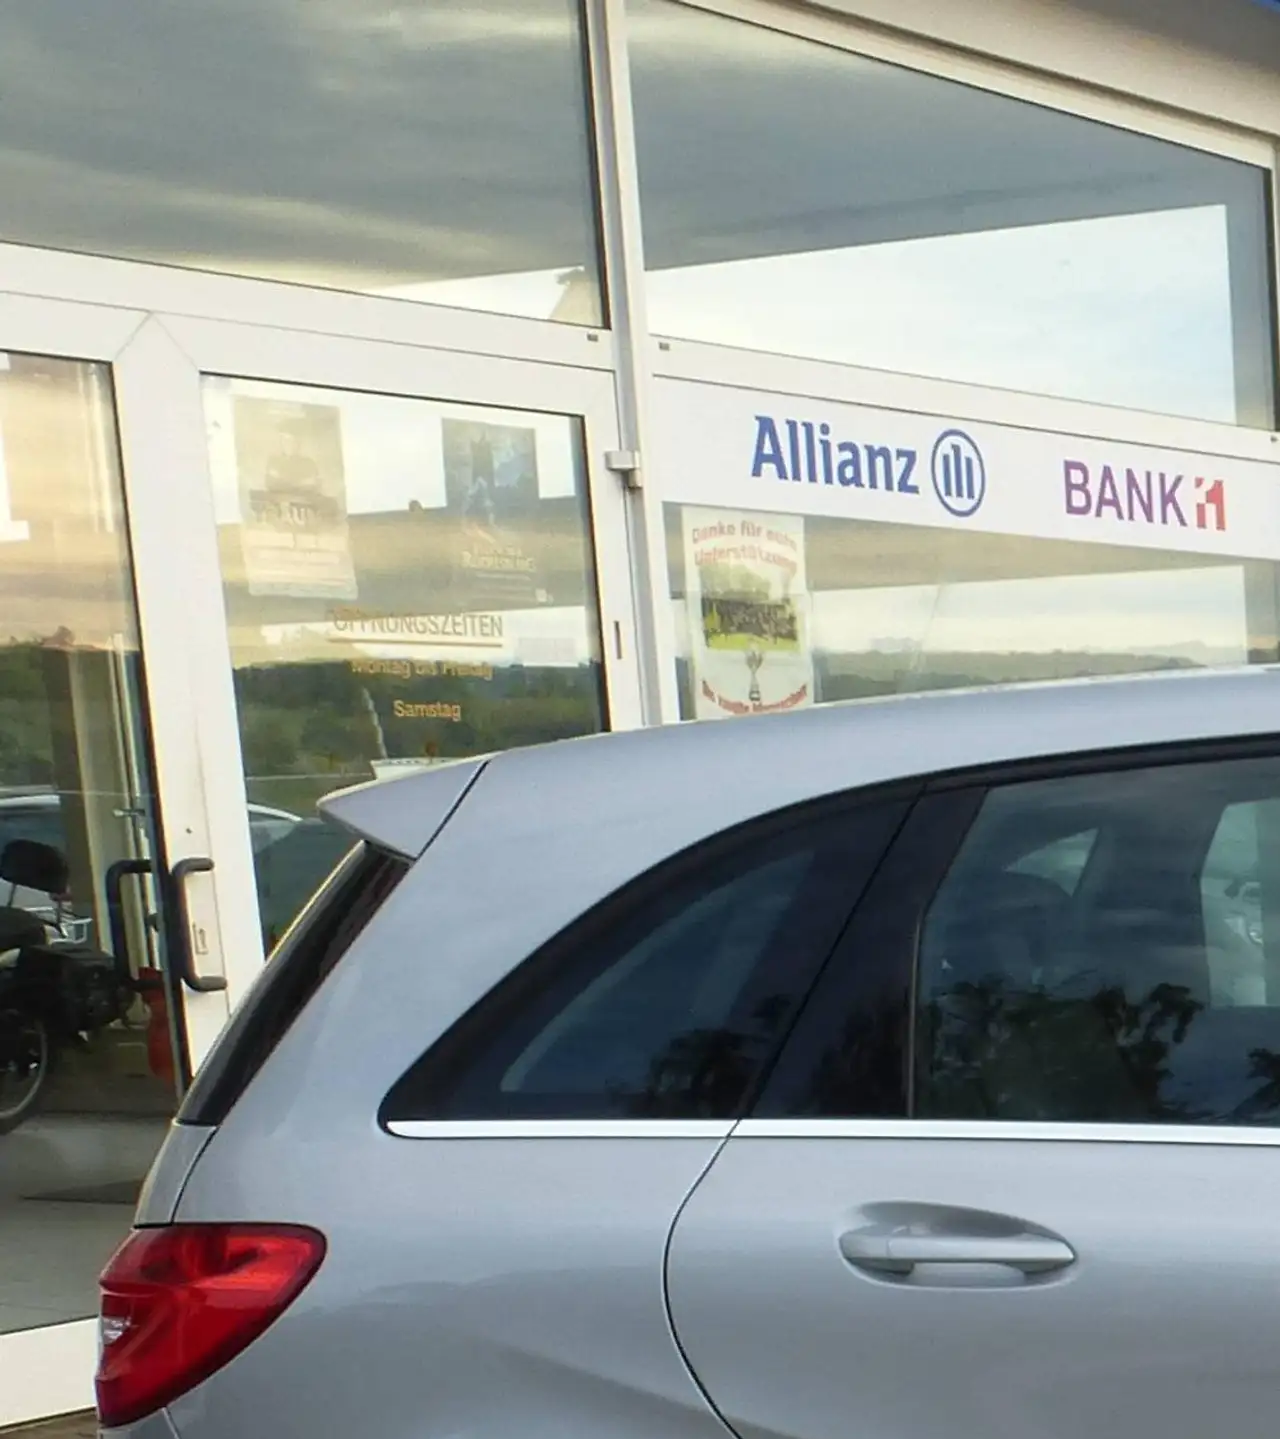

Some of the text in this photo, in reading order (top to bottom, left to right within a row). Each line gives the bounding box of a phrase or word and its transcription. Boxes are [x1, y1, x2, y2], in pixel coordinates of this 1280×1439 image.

[752, 415, 920, 495] Allianz
[692, 520, 736, 545] Danke
[741, 519, 764, 537] für
[393, 699, 462, 722] Samstag
